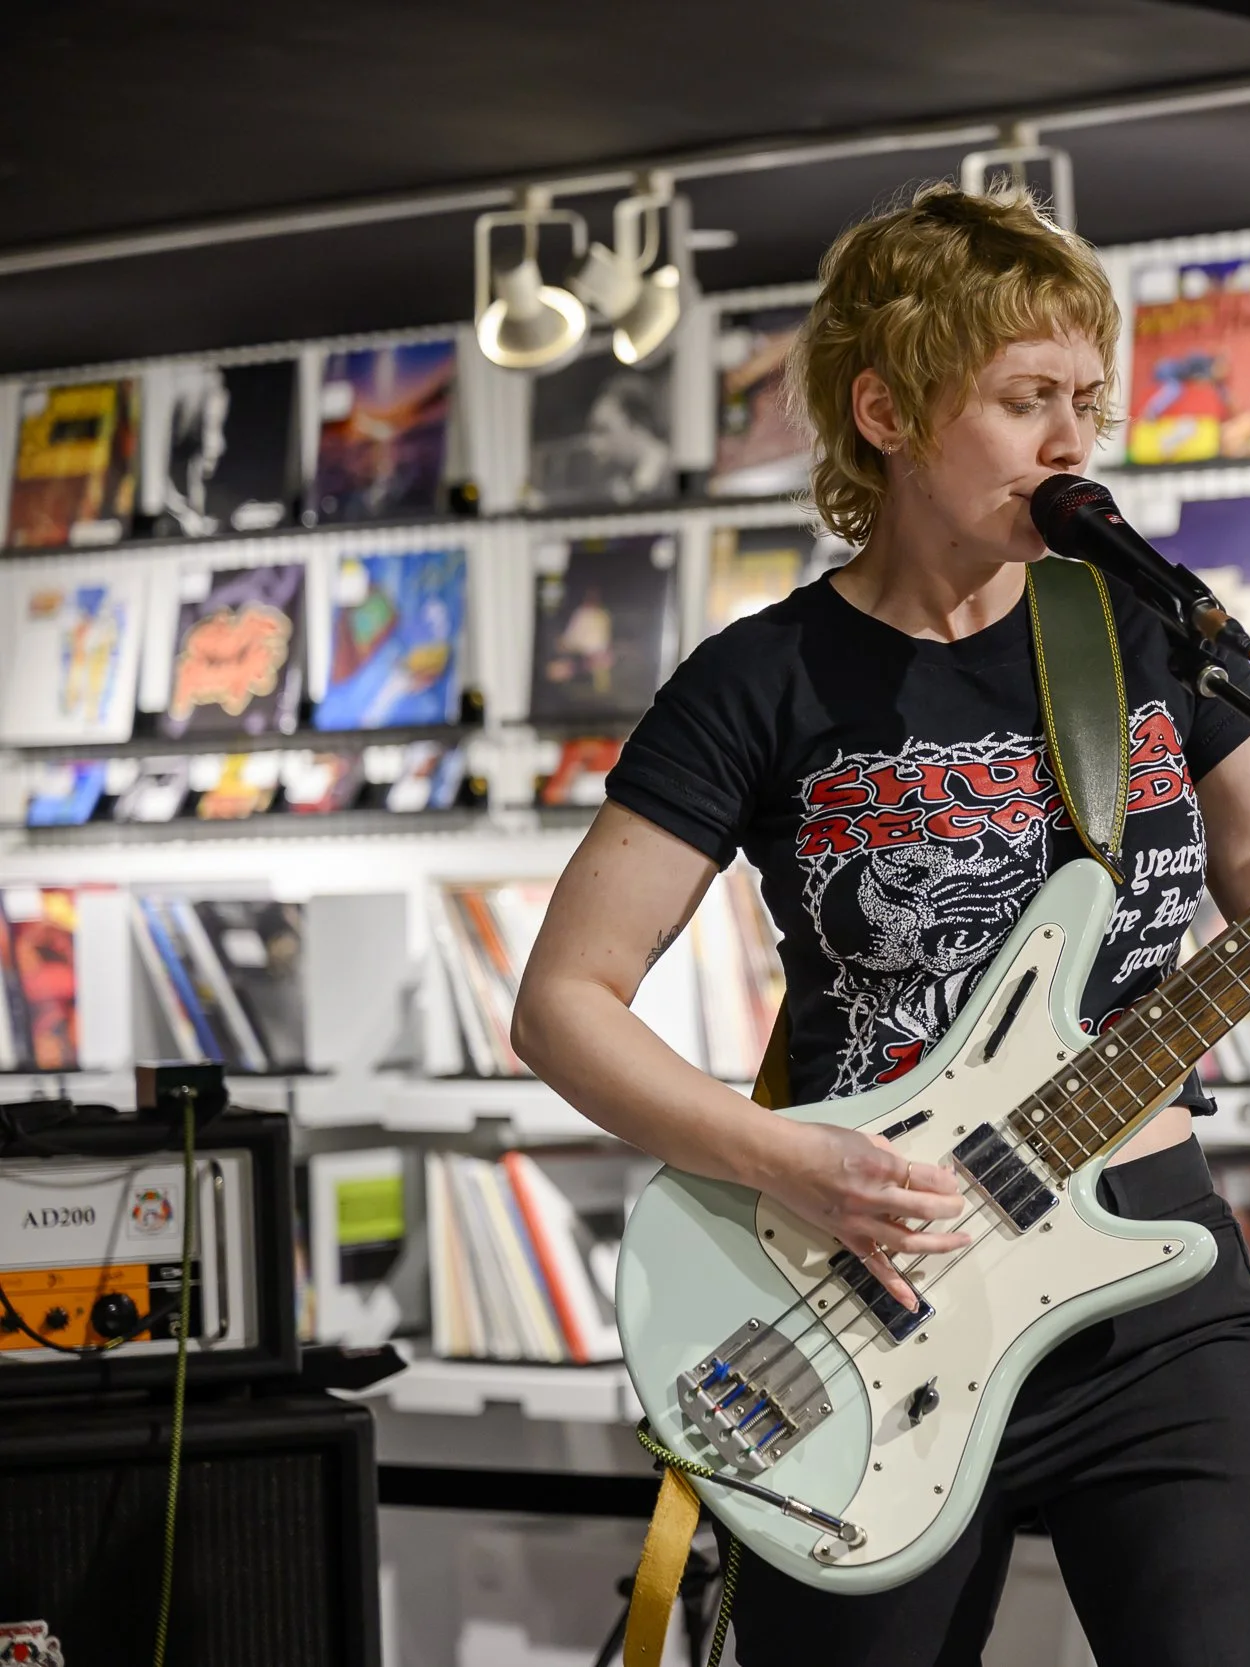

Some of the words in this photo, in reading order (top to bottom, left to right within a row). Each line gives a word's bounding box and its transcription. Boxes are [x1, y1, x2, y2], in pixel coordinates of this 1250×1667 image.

[806, 710, 1183, 812] SHUA
[1105, 896, 1141, 945] he
[22, 1206, 96, 1230] AD200
